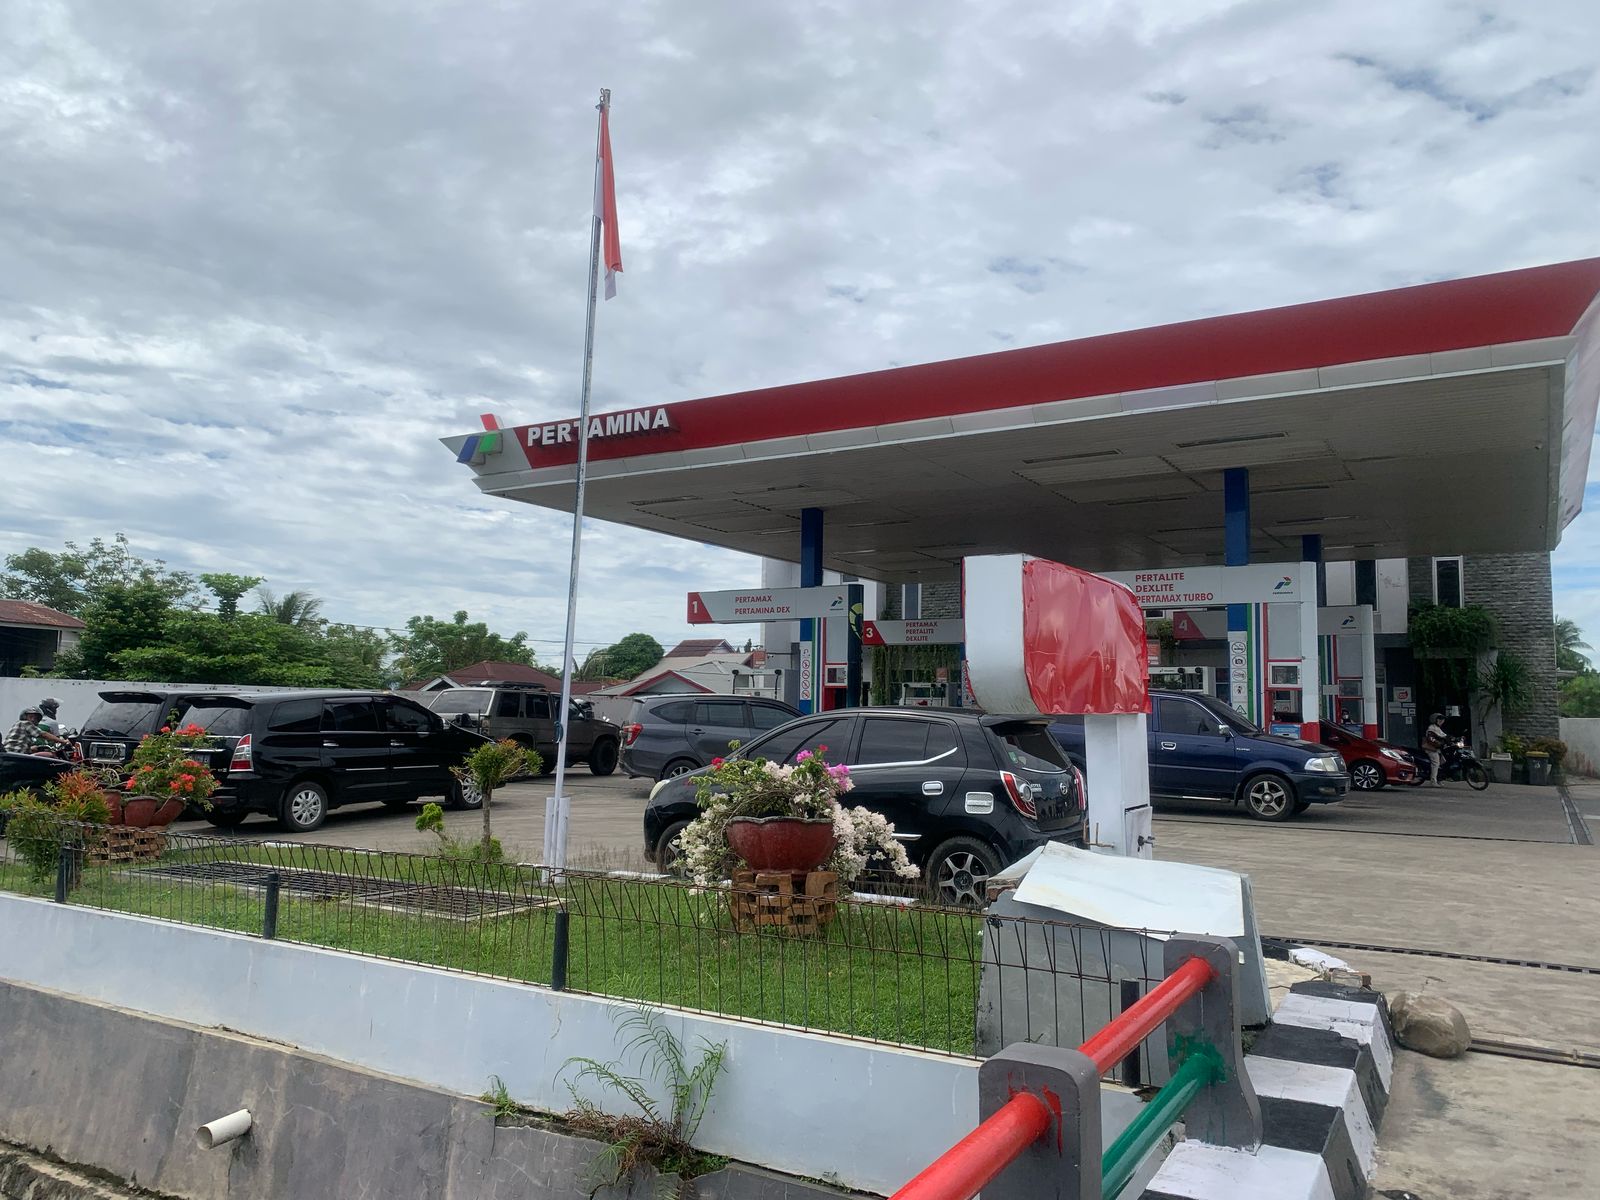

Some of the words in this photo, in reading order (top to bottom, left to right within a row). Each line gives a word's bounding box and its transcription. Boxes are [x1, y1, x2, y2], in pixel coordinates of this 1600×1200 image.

[1135, 572, 1185, 582] PERTALITE
[1135, 583, 1174, 593] DEXLITE
[735, 595, 772, 604] PERTAMAX
[1136, 594, 1181, 604] PERTAMAX
[1184, 592, 1214, 602] TURBO
[692, 600, 698, 614] 1
[734, 606, 775, 615] PERTAMINA
[776, 606, 790, 614] DEX
[1179, 620, 1188, 631] 4
[865, 627, 874, 638] 3
